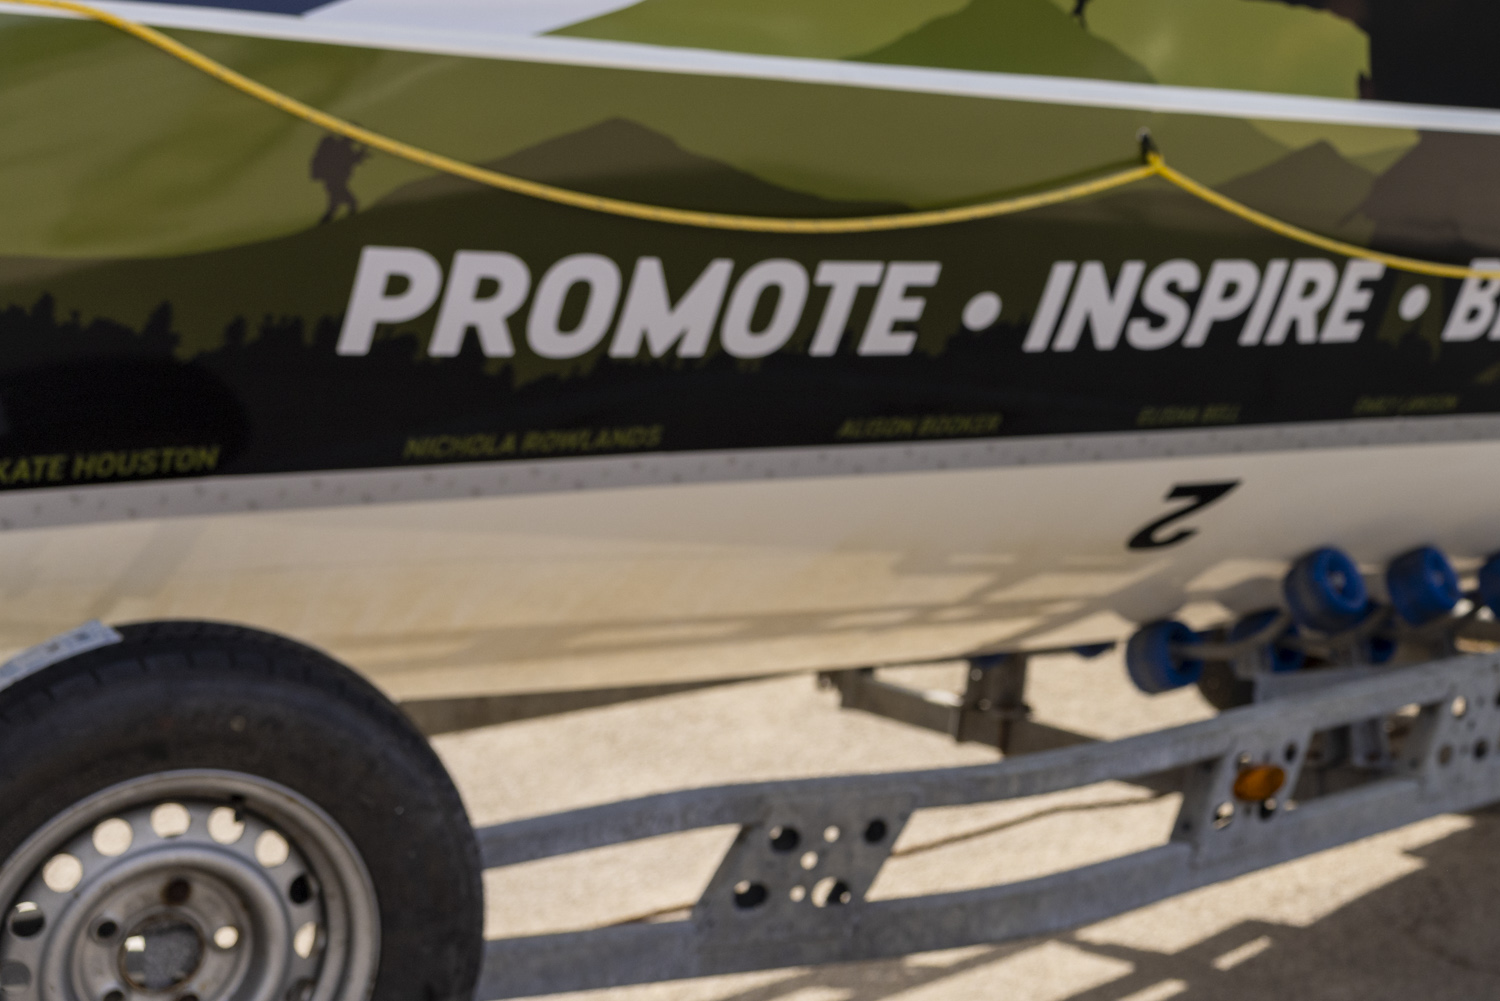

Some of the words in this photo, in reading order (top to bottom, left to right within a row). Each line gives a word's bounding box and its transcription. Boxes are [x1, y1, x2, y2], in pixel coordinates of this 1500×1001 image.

[335, 245, 942, 361] PROMOTE
[1021, 257, 1388, 354] INSPIRE
[71, 444, 222, 481] HOUSTON
[1127, 478, 1242, 551] 2
